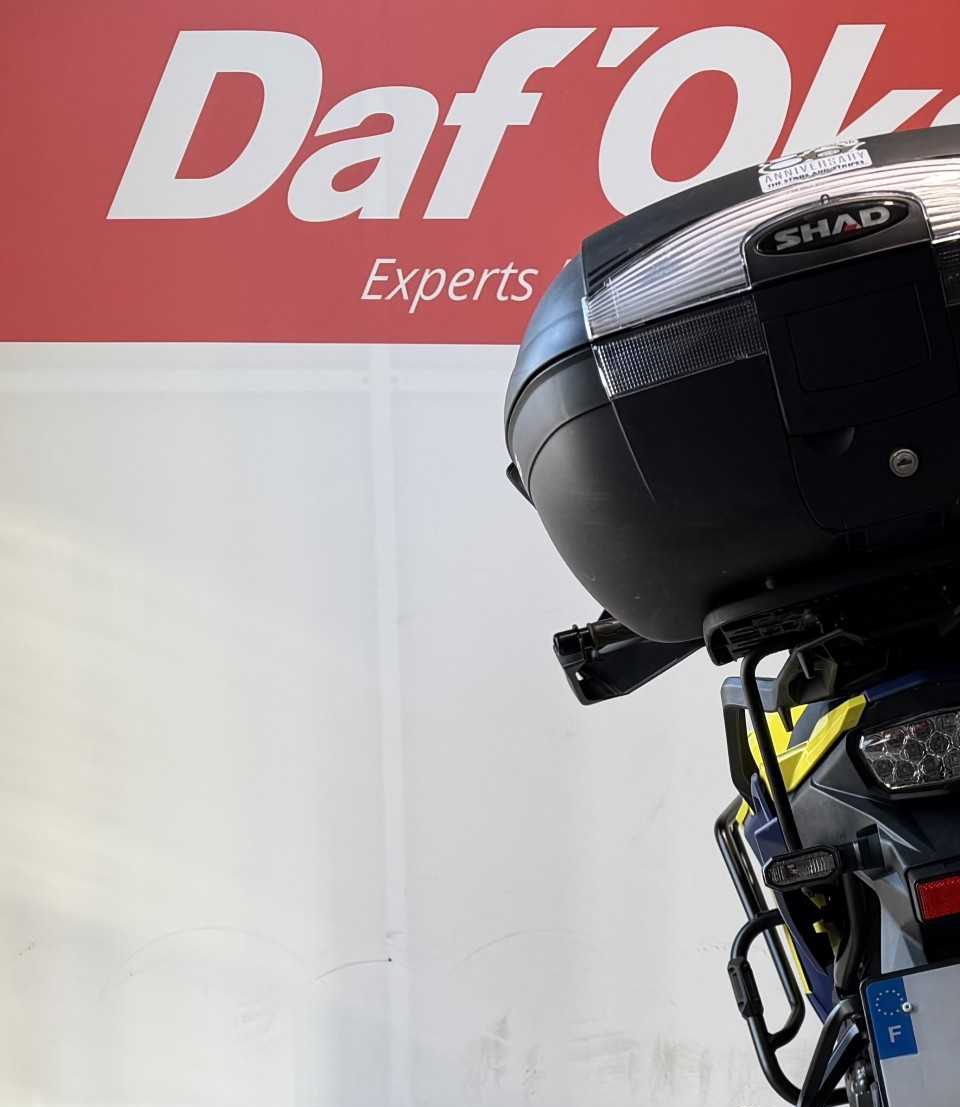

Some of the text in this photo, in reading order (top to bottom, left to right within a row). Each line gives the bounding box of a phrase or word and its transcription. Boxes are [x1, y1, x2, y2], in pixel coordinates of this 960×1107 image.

[774, 206, 890, 250] SHAD
[361, 259, 534, 313] Experts
[888, 1025, 902, 1043] F
